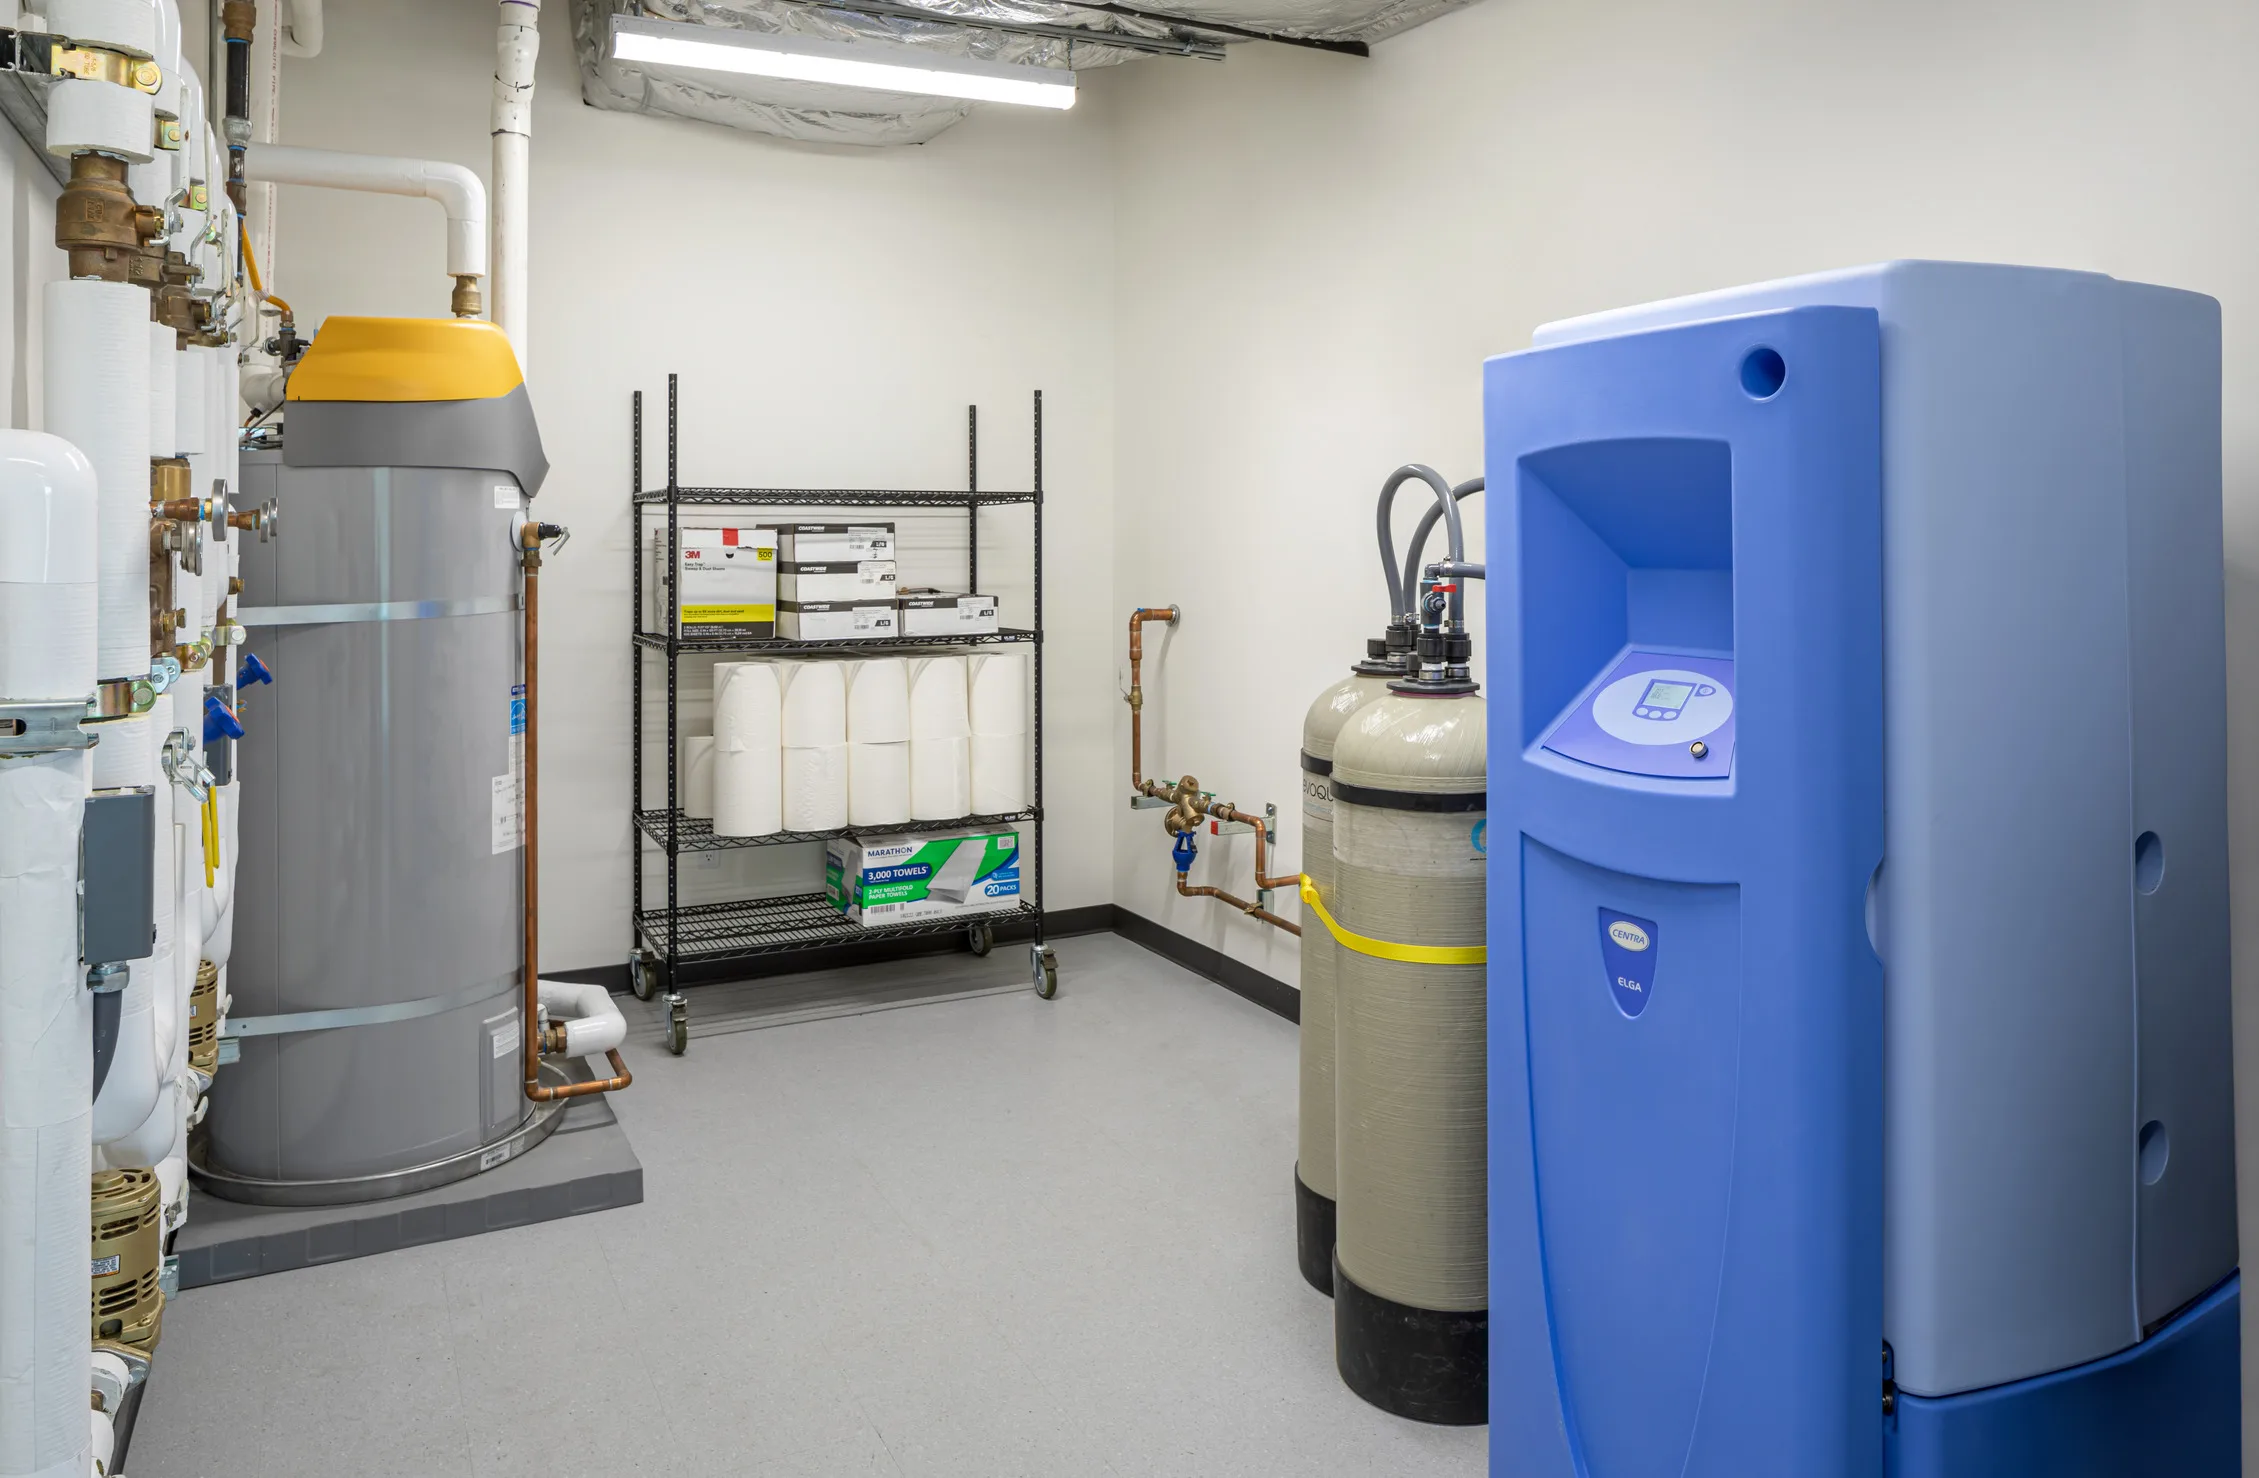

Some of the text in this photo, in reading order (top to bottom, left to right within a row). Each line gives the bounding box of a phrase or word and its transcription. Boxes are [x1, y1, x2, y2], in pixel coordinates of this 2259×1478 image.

[684, 550, 701, 559] 3M
[867, 846, 913, 857] MARATHON
[868, 866, 927, 881] 3,000 TOWELS
[883, 884, 914, 893] MULTIFOLD
[886, 890, 908, 898] TOWELS
[986, 884, 1017, 896] 20 PACKS
[1612, 928, 1646, 945] CENTRA
[1617, 976, 1642, 993] ELGA
